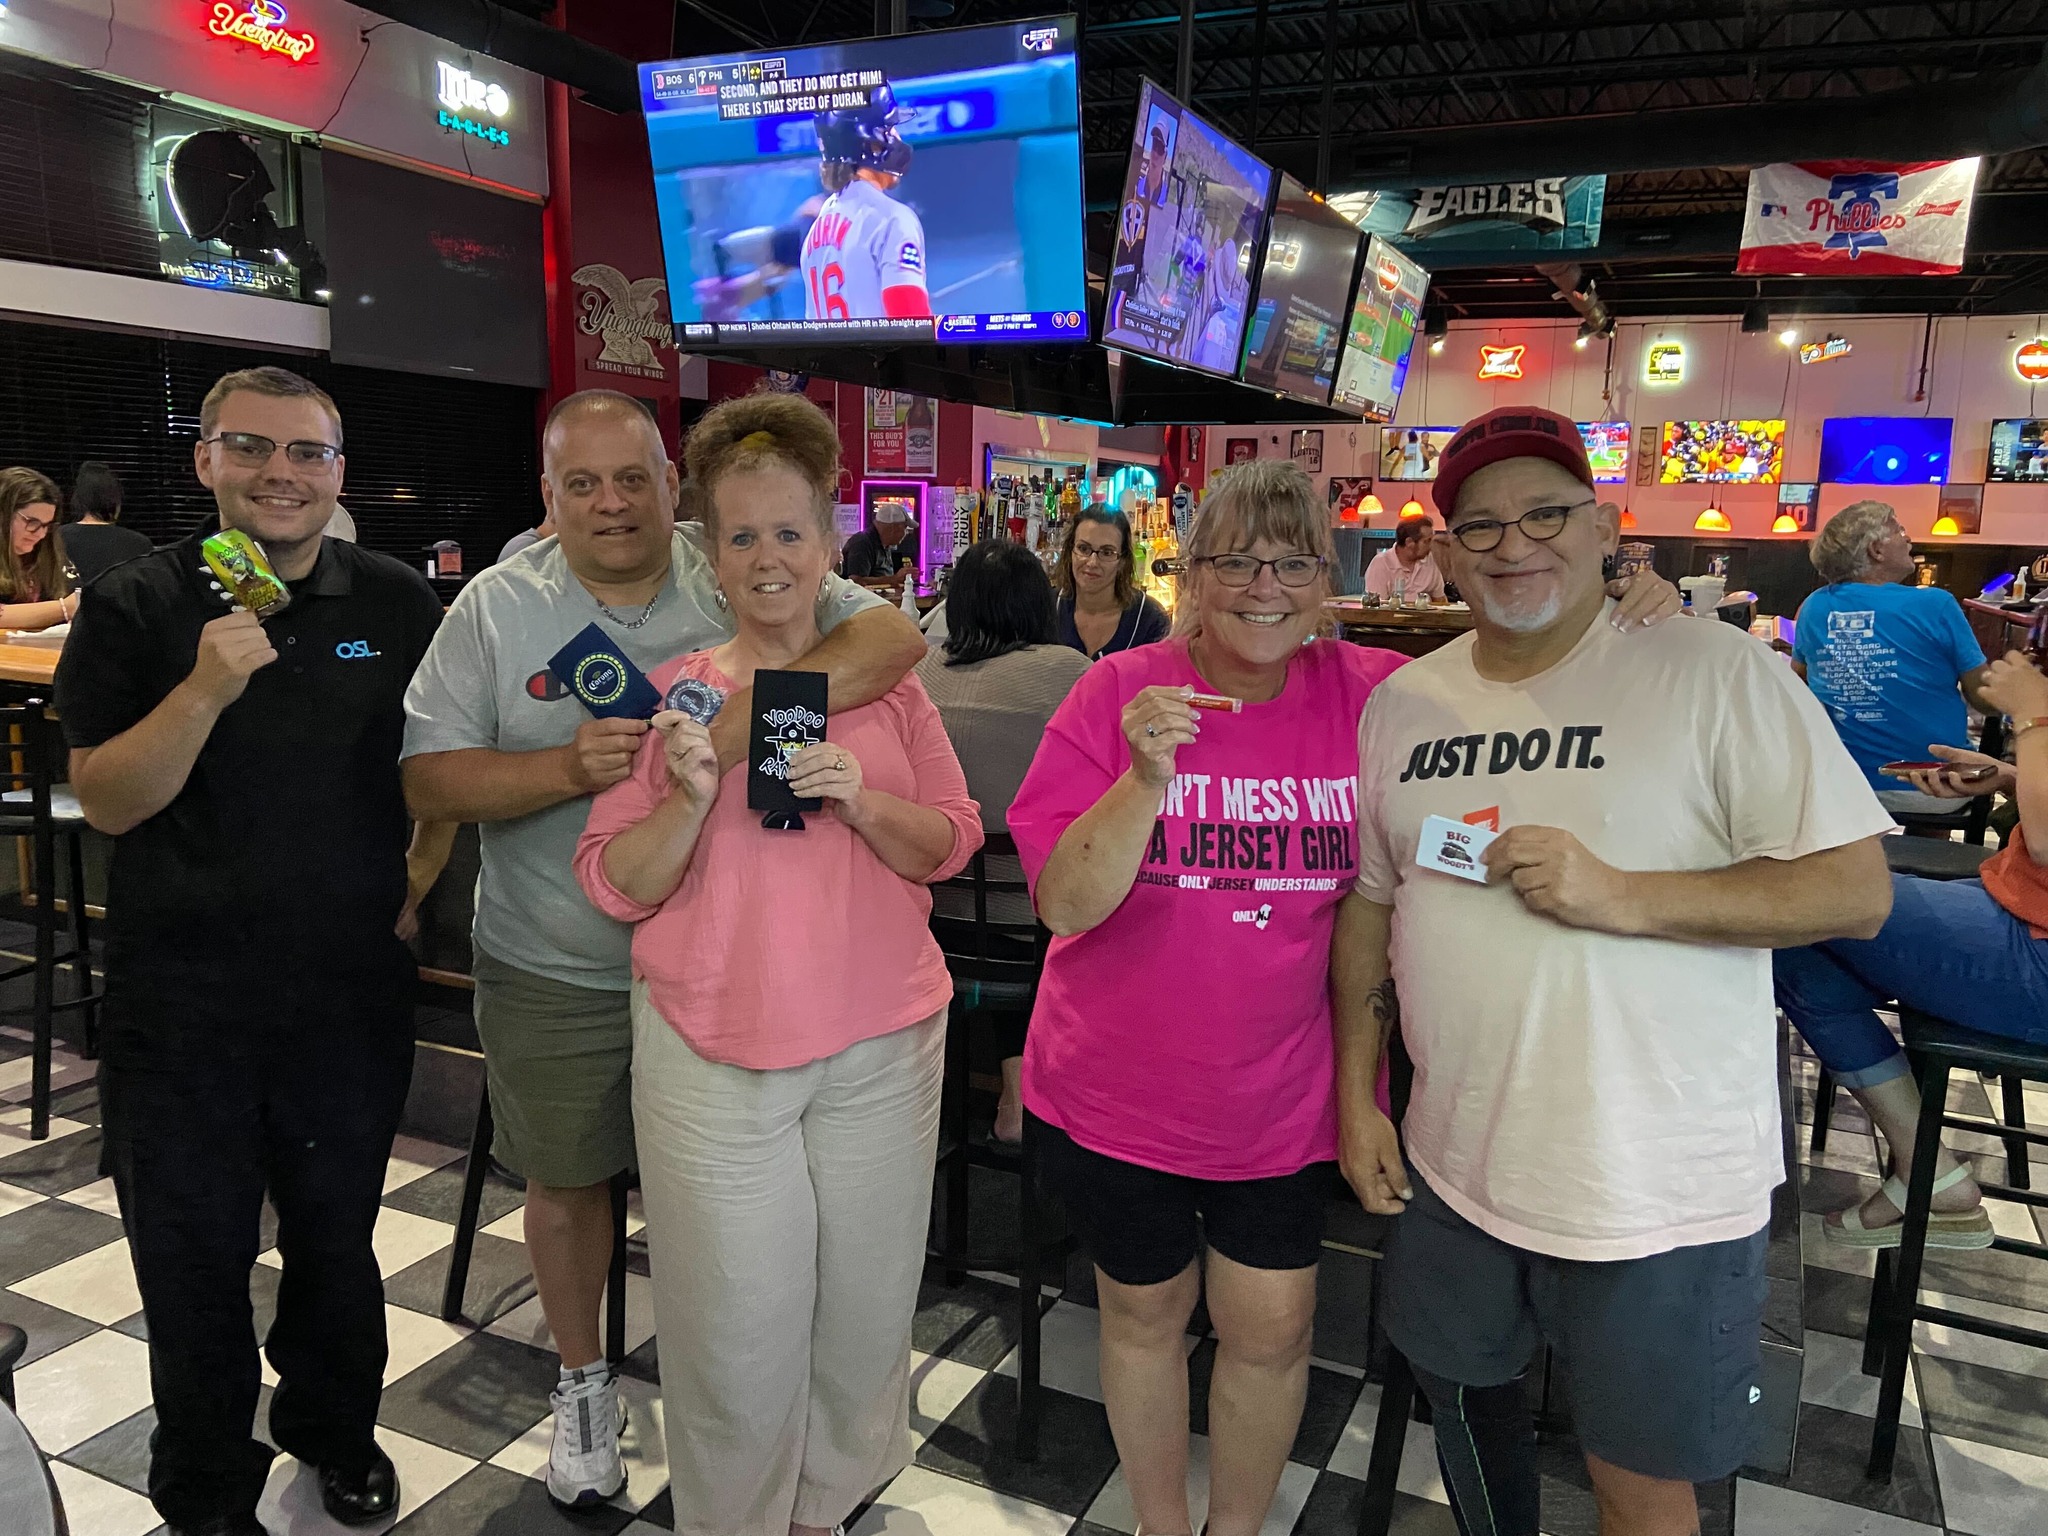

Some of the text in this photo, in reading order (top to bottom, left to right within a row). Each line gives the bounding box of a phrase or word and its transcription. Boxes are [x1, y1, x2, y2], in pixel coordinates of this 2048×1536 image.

[209, 2, 315, 61] Yuengling
[1029, 27, 1059, 41] ESPN
[665, 74, 683, 85] BOS
[688, 72, 695, 84] 6
[708, 70, 723, 80] PHI
[731, 68, 739, 79] 5
[720, 82, 760, 99] SECOND,
[760, 80, 778, 94] AND
[779, 77, 802, 93] THEY
[804, 77, 818, 90] DO
[819, 74, 840, 88] NOT
[840, 72, 859, 87] GET
[860, 69, 883, 85] HIM!
[721, 91, 867, 118] THERE IS THAT SPEED OF DURAN.
[1405, 176, 1568, 232] EAGLES
[1805, 198, 1906, 232] Phillies
[580, 291, 672, 349] Yuengling
[718, 324, 729, 332] TOP
[730, 323, 747, 332] NEWS
[751, 322, 771, 331] Shohei
[791, 321, 803, 329] ties
[803, 321, 828, 331] Dodgers
[828, 320, 847, 329] record
[847, 320, 861, 328] with
[861, 320, 871, 328] HR
[879, 319, 890, 327] 5th
[890, 319, 914, 329] straight
[914, 320, 933, 328] game
[595, 360, 664, 379] SPREAD YOUR WINGS
[870, 432, 903, 440] THIS BUD'S
[873, 440, 900, 448] FOR YOU
[1309, 457, 1319, 465] 16
[960, 506, 969, 547] TRULY
[588, 668, 614, 691] Corona
[762, 705, 825, 728] VOODOO
[1400, 725, 1605, 783] JUST DO IT.
[1221, 776, 1299, 822] MESS
[1149, 820, 1354, 871] A JERSEY GIRL
[1446, 830, 1472, 845] BIG
